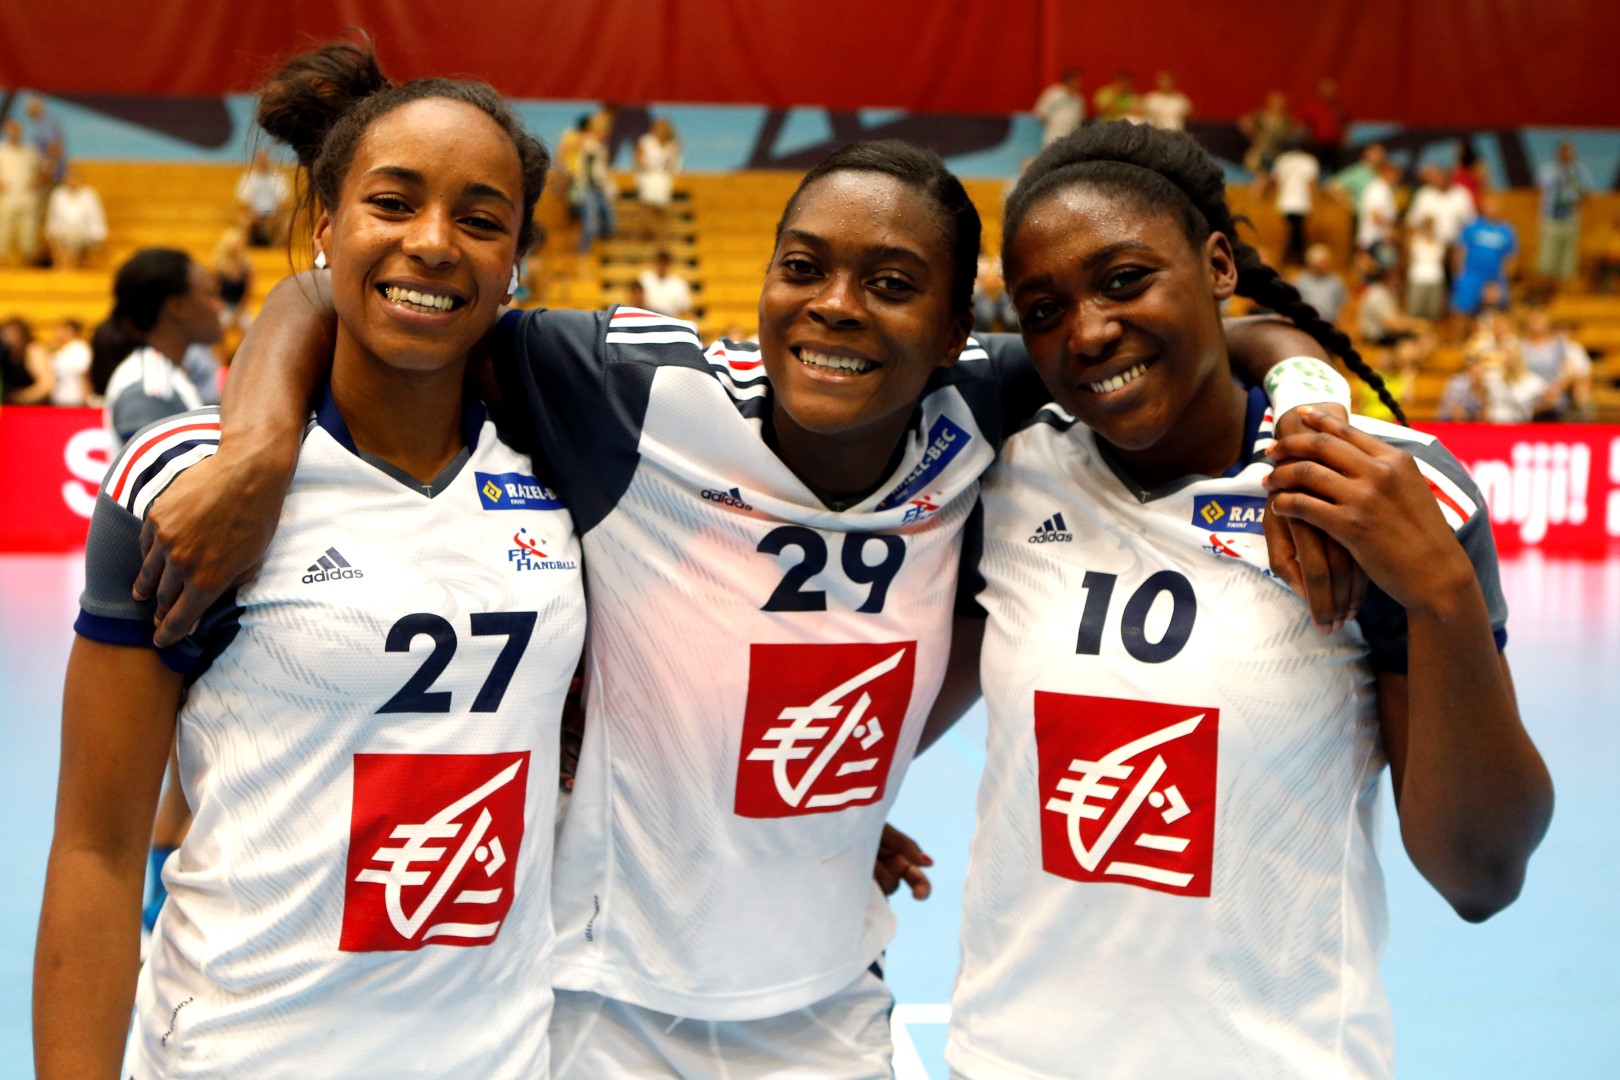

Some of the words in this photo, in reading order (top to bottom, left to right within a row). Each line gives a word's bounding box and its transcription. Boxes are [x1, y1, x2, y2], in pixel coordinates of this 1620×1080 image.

[505, 483, 560, 500] RAZEL-B
[892, 428, 957, 493] EL-BEC
[1461, 441, 1590, 544] niji!
[701, 488, 753, 511] adidas
[757, 525, 907, 614] 29
[1028, 530, 1073, 544] adidas
[301, 566, 364, 584] adidas
[1075, 569, 1198, 664] 10
[374, 611, 538, 714] 27
